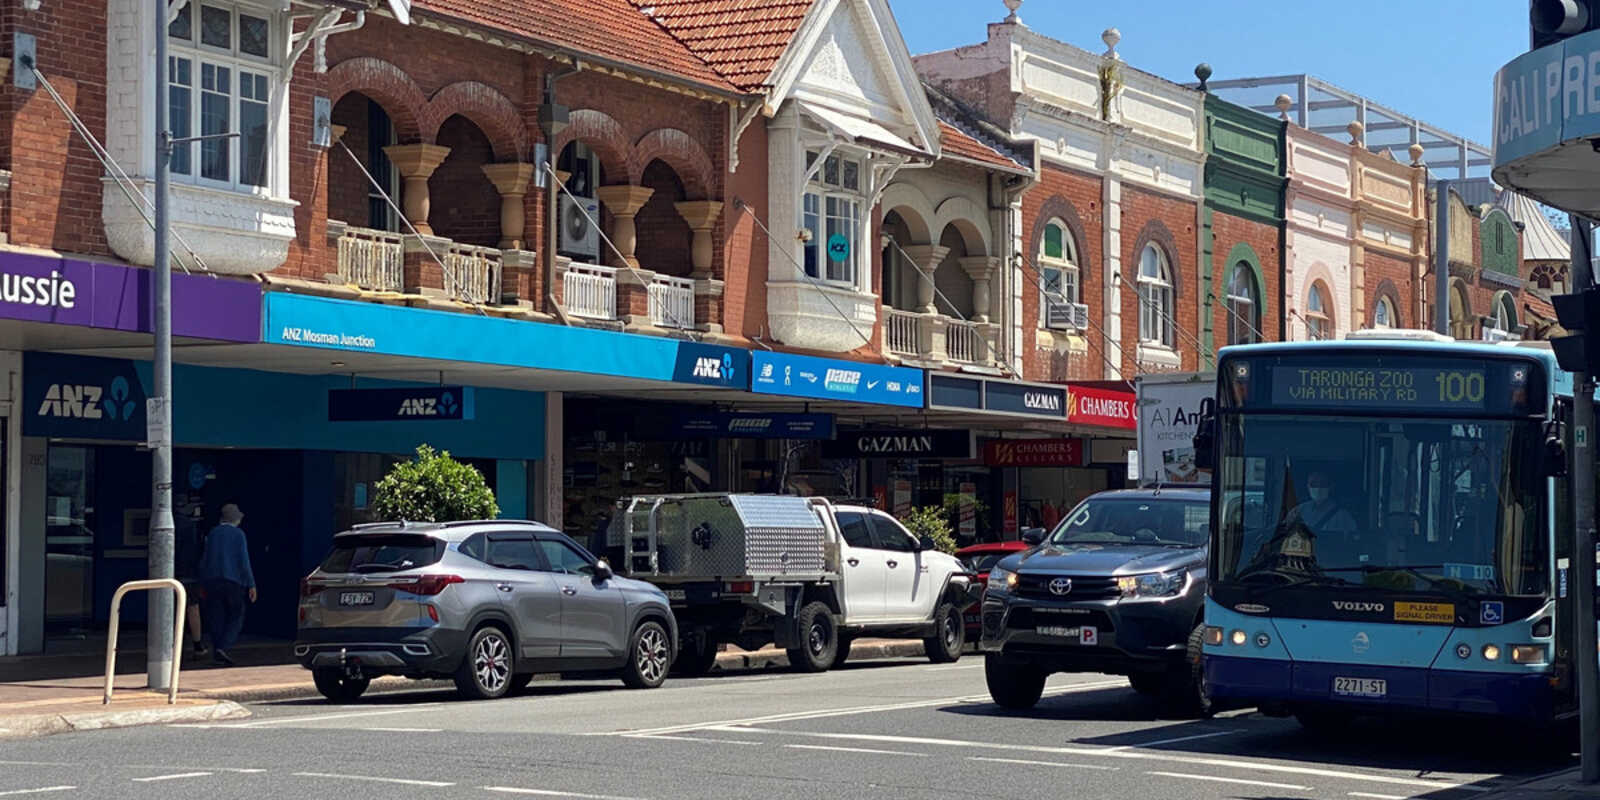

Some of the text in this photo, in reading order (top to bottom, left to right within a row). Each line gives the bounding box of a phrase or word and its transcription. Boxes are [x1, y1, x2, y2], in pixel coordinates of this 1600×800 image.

[1500, 69, 1539, 144] CALI
[282, 325, 376, 349] ANZ Mosman Junction
[693, 357, 721, 378] ANZ
[825, 368, 862, 388] pace
[1298, 369, 1413, 387] TARONGA ZOO
[1435, 371, 1485, 402] 100
[38, 383, 103, 419] ANZ
[1024, 392, 1060, 410] GAZMAN
[1289, 387, 1417, 401] VIA MILITARY RD
[398, 398, 438, 415] ANZ
[1080, 396, 1130, 420] CHAMBERS
[857, 436, 932, 453] GAZMAN
[1576, 430, 1585, 442] H
[1016, 443, 1073, 453] CHAMBERS
[1016, 454, 1073, 463] CELLARS
[1332, 600, 1385, 612] VOLVO
[1409, 603, 1439, 612] PLEASE
[1396, 611, 1453, 621] SIGNAL DRIVER
[1083, 629, 1093, 642] P
